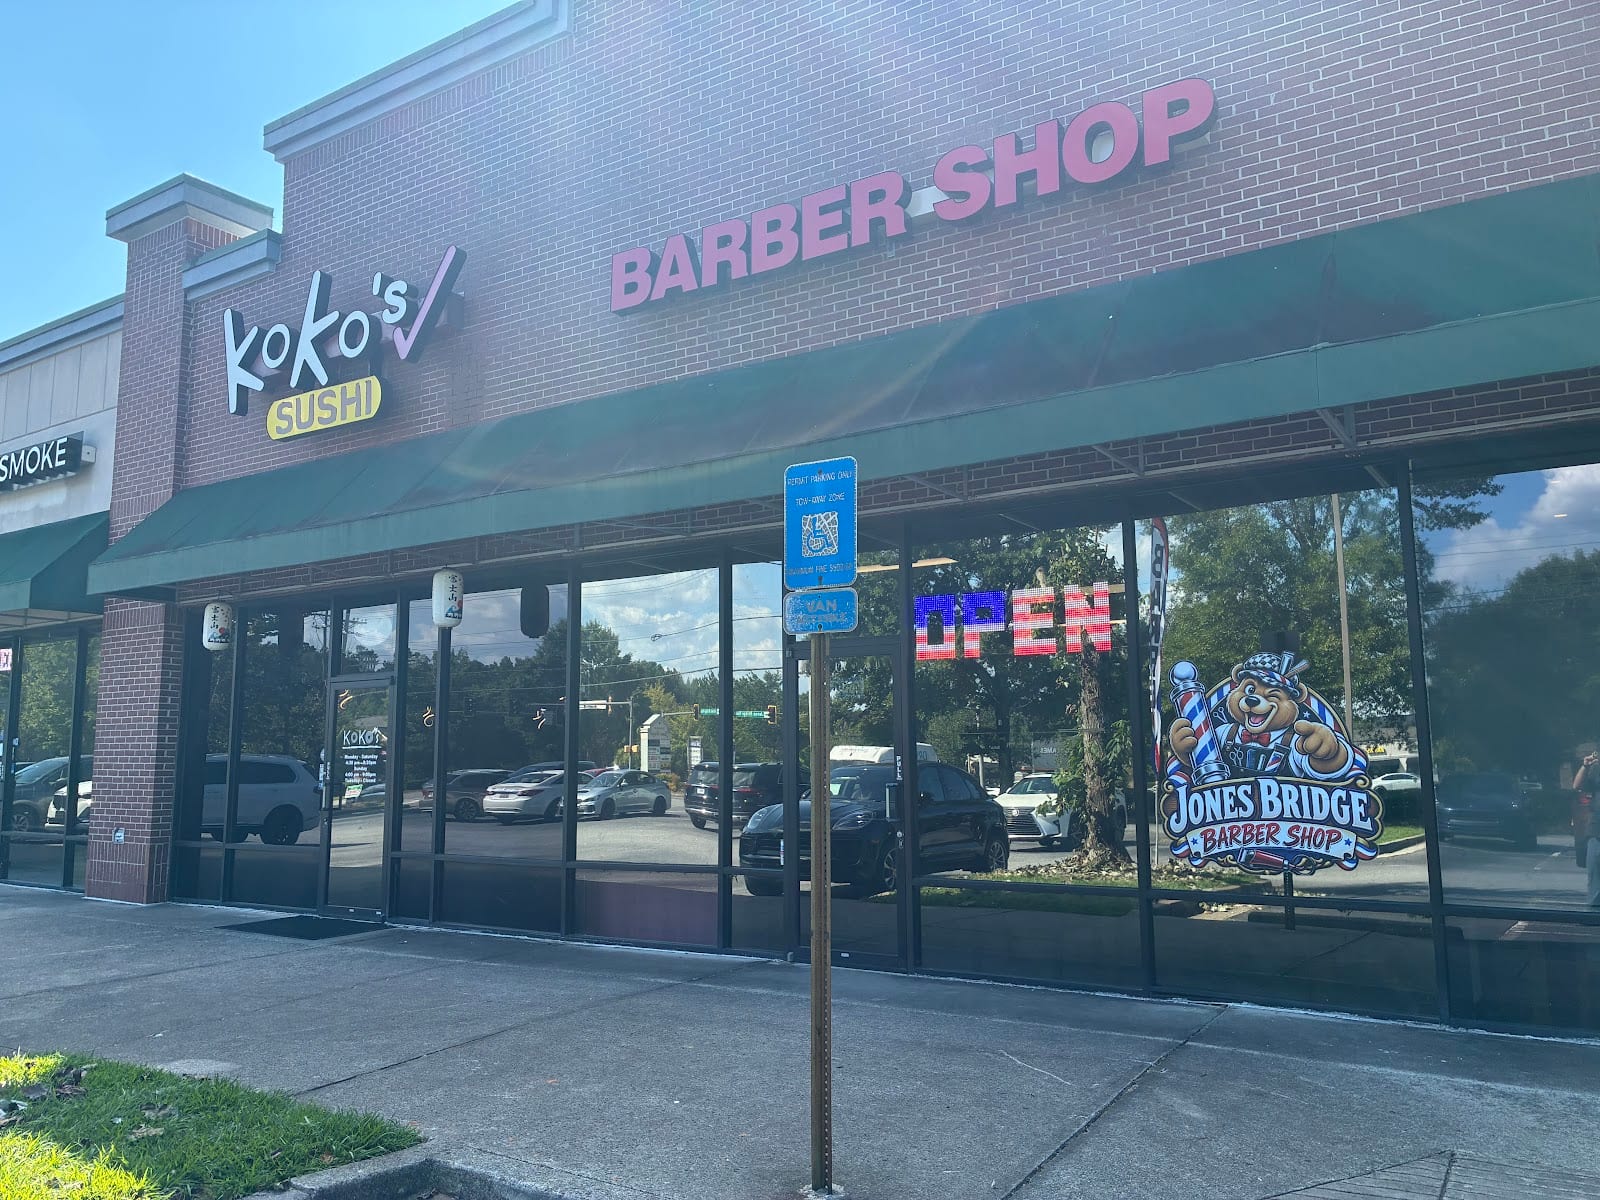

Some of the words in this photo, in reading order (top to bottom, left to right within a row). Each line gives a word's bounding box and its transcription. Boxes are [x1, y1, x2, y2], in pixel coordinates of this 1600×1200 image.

[609, 170, 908, 313] BARBER
[932, 77, 1217, 222] SHOP
[274, 379, 373, 436] SUSHI
[0, 437, 67, 482] SMOKE
[810, 471, 836, 484] PARKING
[829, 492, 845, 502] ZONE
[806, 599, 838, 613] VAN
[914, 581, 1113, 661] OPEN
[1169, 783, 1254, 834] JONES
[1256, 777, 1373, 832] BRIDGE
[1200, 822, 1281, 854] BARBER
[1283, 824, 1343, 852] SHOP
